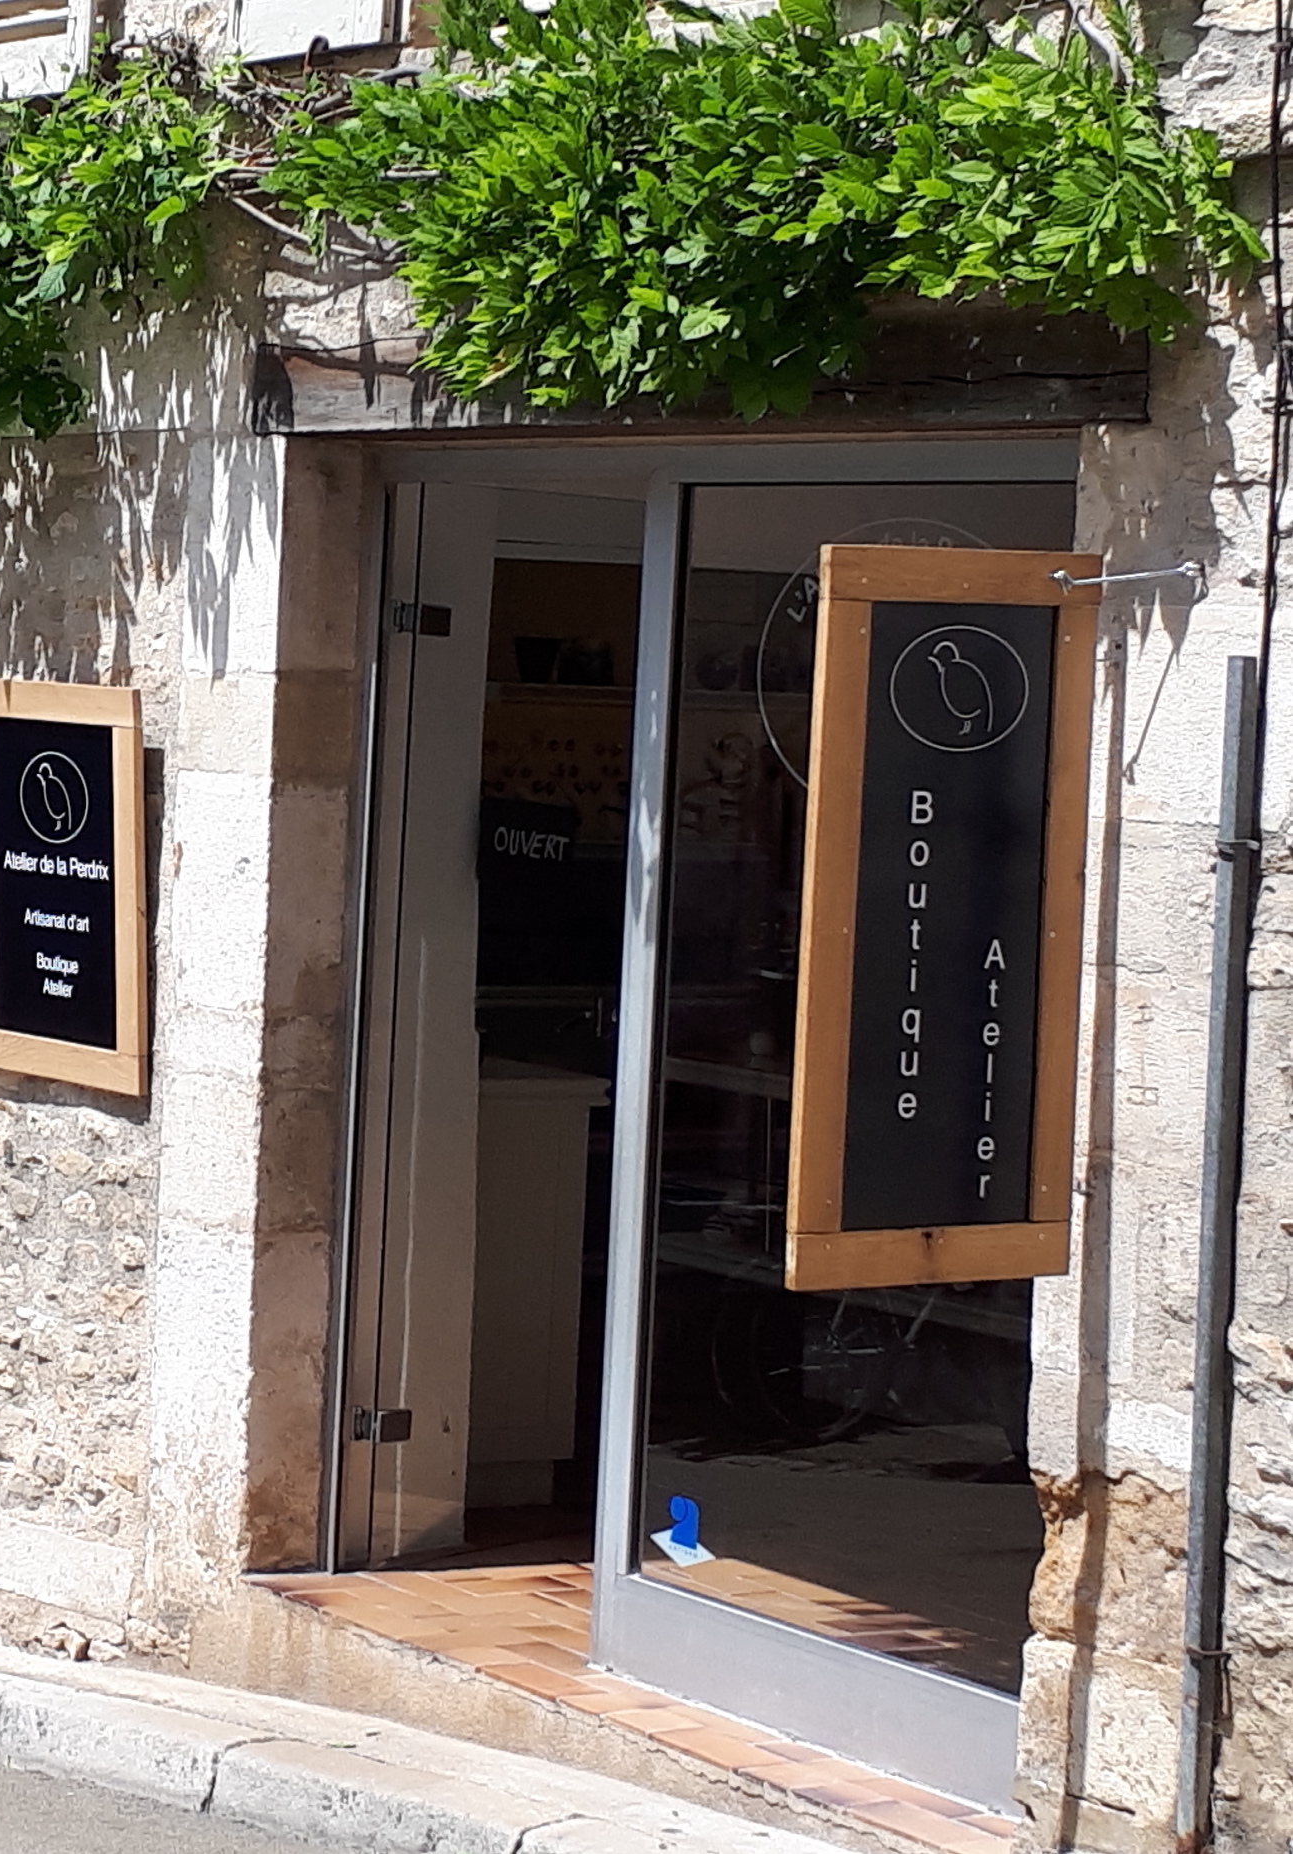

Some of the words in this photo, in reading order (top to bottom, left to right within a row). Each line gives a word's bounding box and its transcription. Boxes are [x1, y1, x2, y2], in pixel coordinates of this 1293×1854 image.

[494, 826, 569, 861] OUVERT
[3, 850, 39, 872] Atelier
[39, 854, 55, 875] de
[56, 856, 68, 876] la
[69, 857, 109, 881] Perdrix
[24, 907, 66, 929] Artisanat
[67, 914, 90, 933] d'art
[36, 951, 79, 977] Boutique
[897, 789, 934, 1119] Boutique
[43, 977, 74, 998] Atelier
[976, 938, 1006, 1199] Atelier
